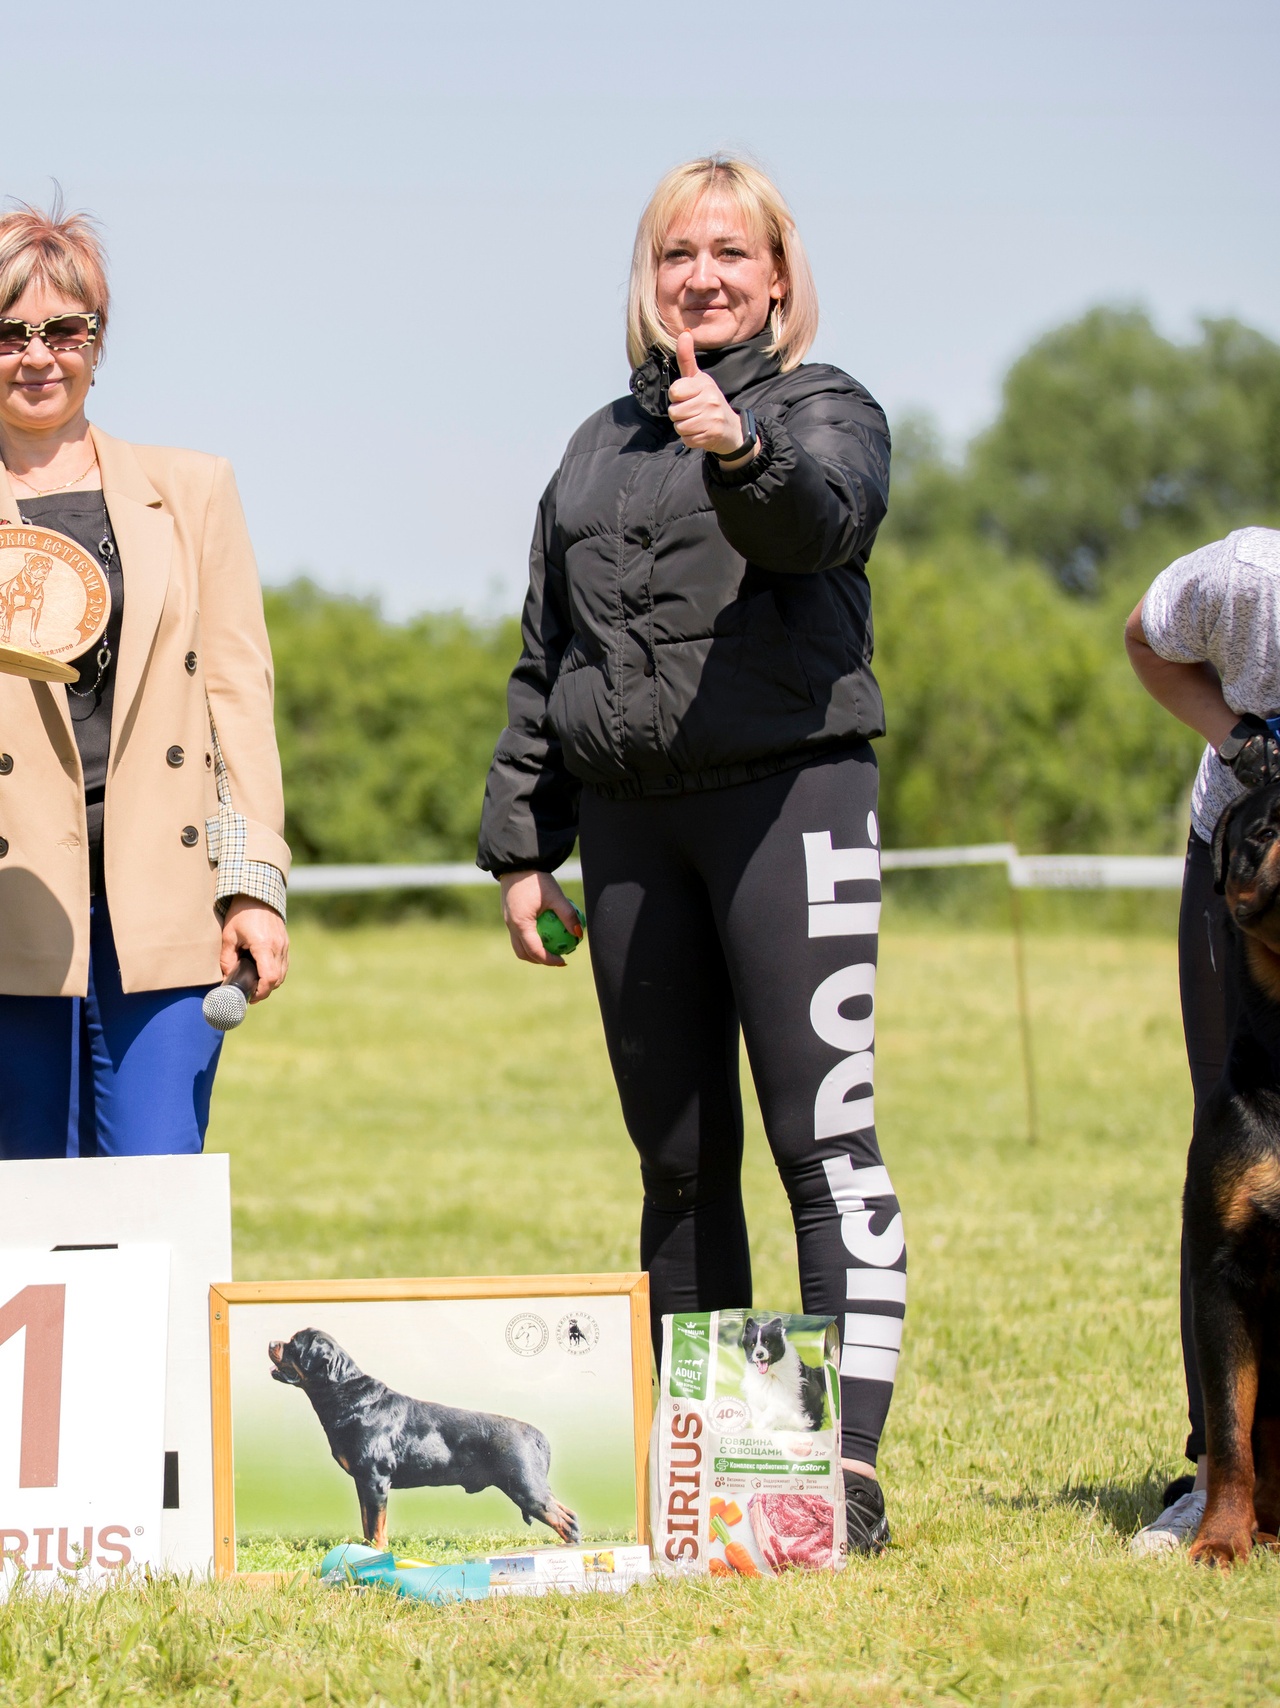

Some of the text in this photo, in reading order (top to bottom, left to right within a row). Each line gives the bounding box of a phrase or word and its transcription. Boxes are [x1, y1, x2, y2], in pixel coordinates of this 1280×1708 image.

[43, 537, 101, 592] ВСТРЕЧИ
[84, 597, 104, 632] 2023
[810, 961, 876, 1140] DO
[675, 1367, 702, 1381] ADULT
[716, 1408, 744, 1419] 40%
[720, 1437, 773, 1446] ГОВЯДИНА
[720, 1446, 782, 1456] С ОВОЩАМИ
[729, 1462, 756, 1470] Комплекс
[791, 1463, 826, 1472] ProStor+
